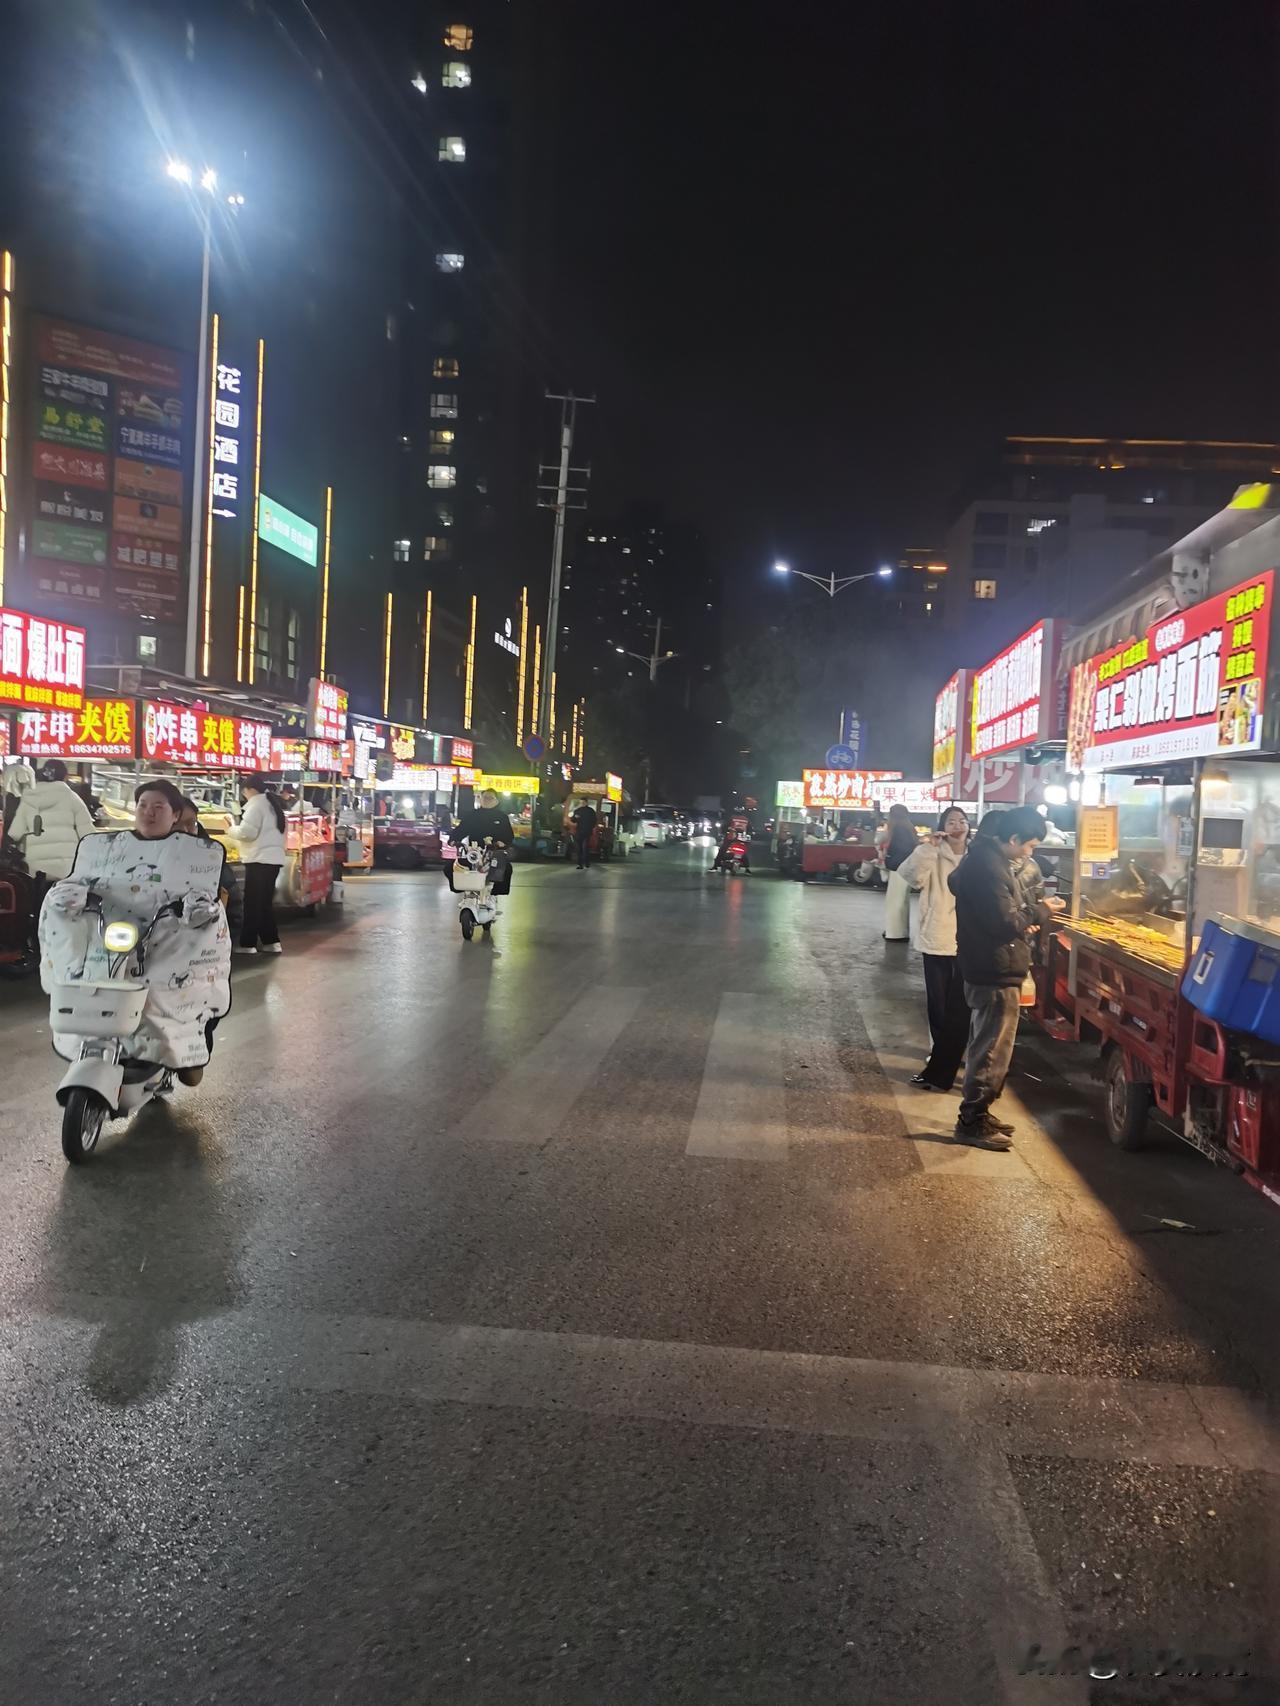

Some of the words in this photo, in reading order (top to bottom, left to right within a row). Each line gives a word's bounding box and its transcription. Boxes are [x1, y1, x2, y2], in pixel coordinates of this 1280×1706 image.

[213, 363, 242, 500] 花园酒店
[156, 706, 198, 750] 炸串
[203, 716, 234, 755] 夹馍
